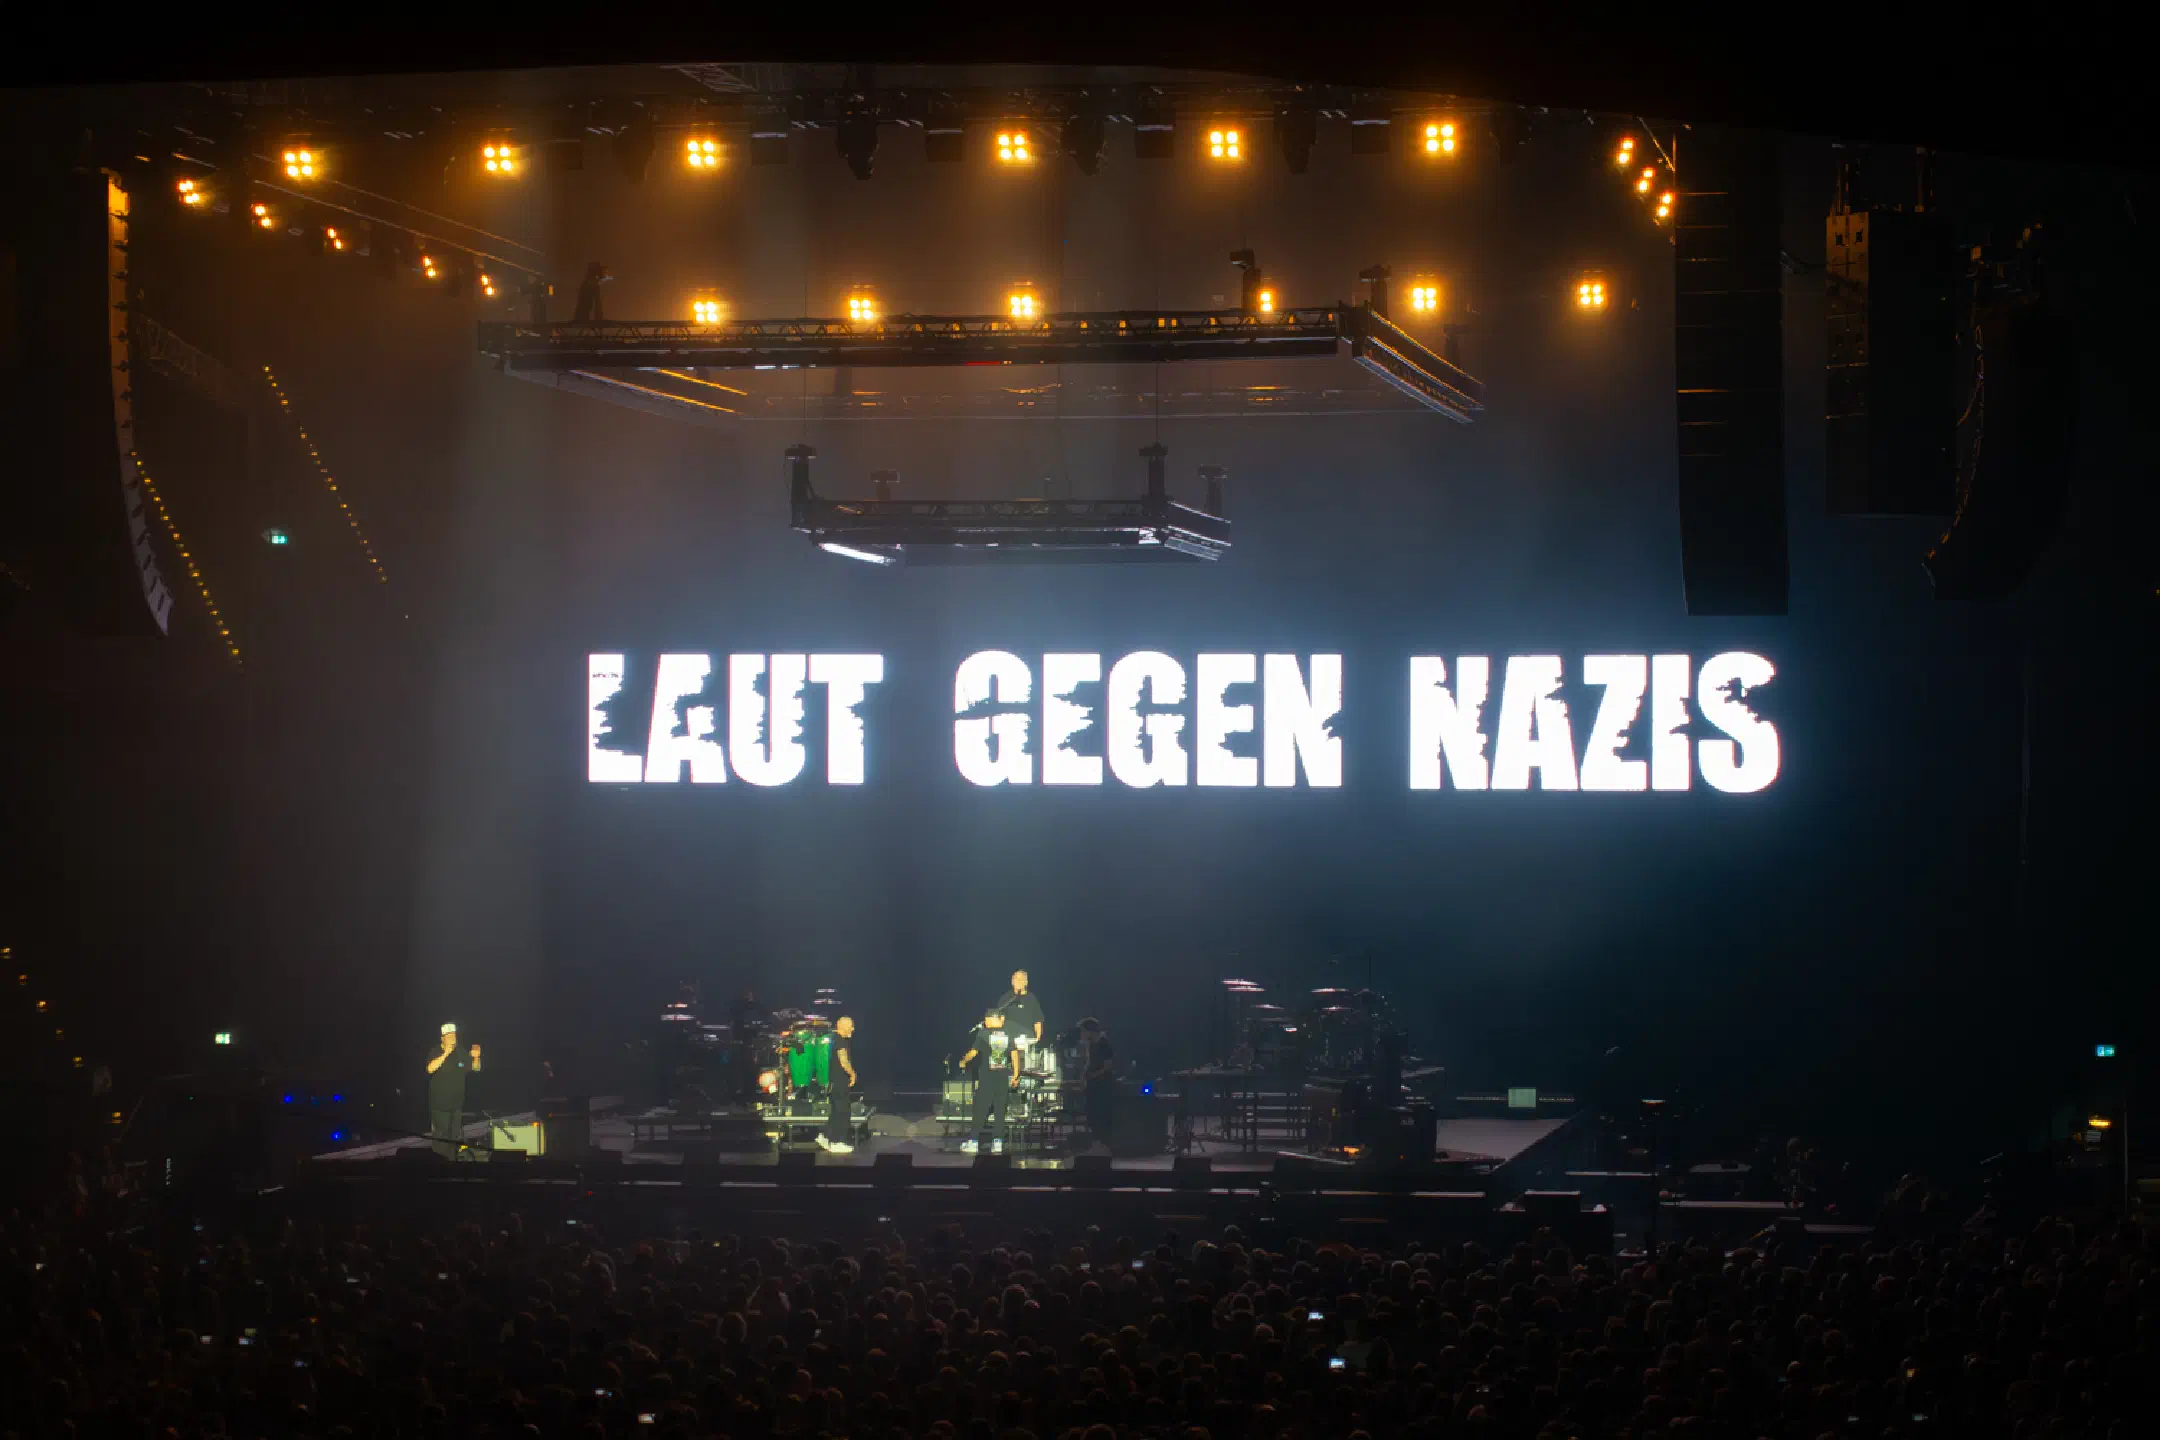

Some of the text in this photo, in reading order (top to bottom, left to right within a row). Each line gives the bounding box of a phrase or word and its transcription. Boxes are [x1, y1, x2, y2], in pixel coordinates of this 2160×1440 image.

[588, 649, 1780, 793] LAUT GEGEN NAZIS
